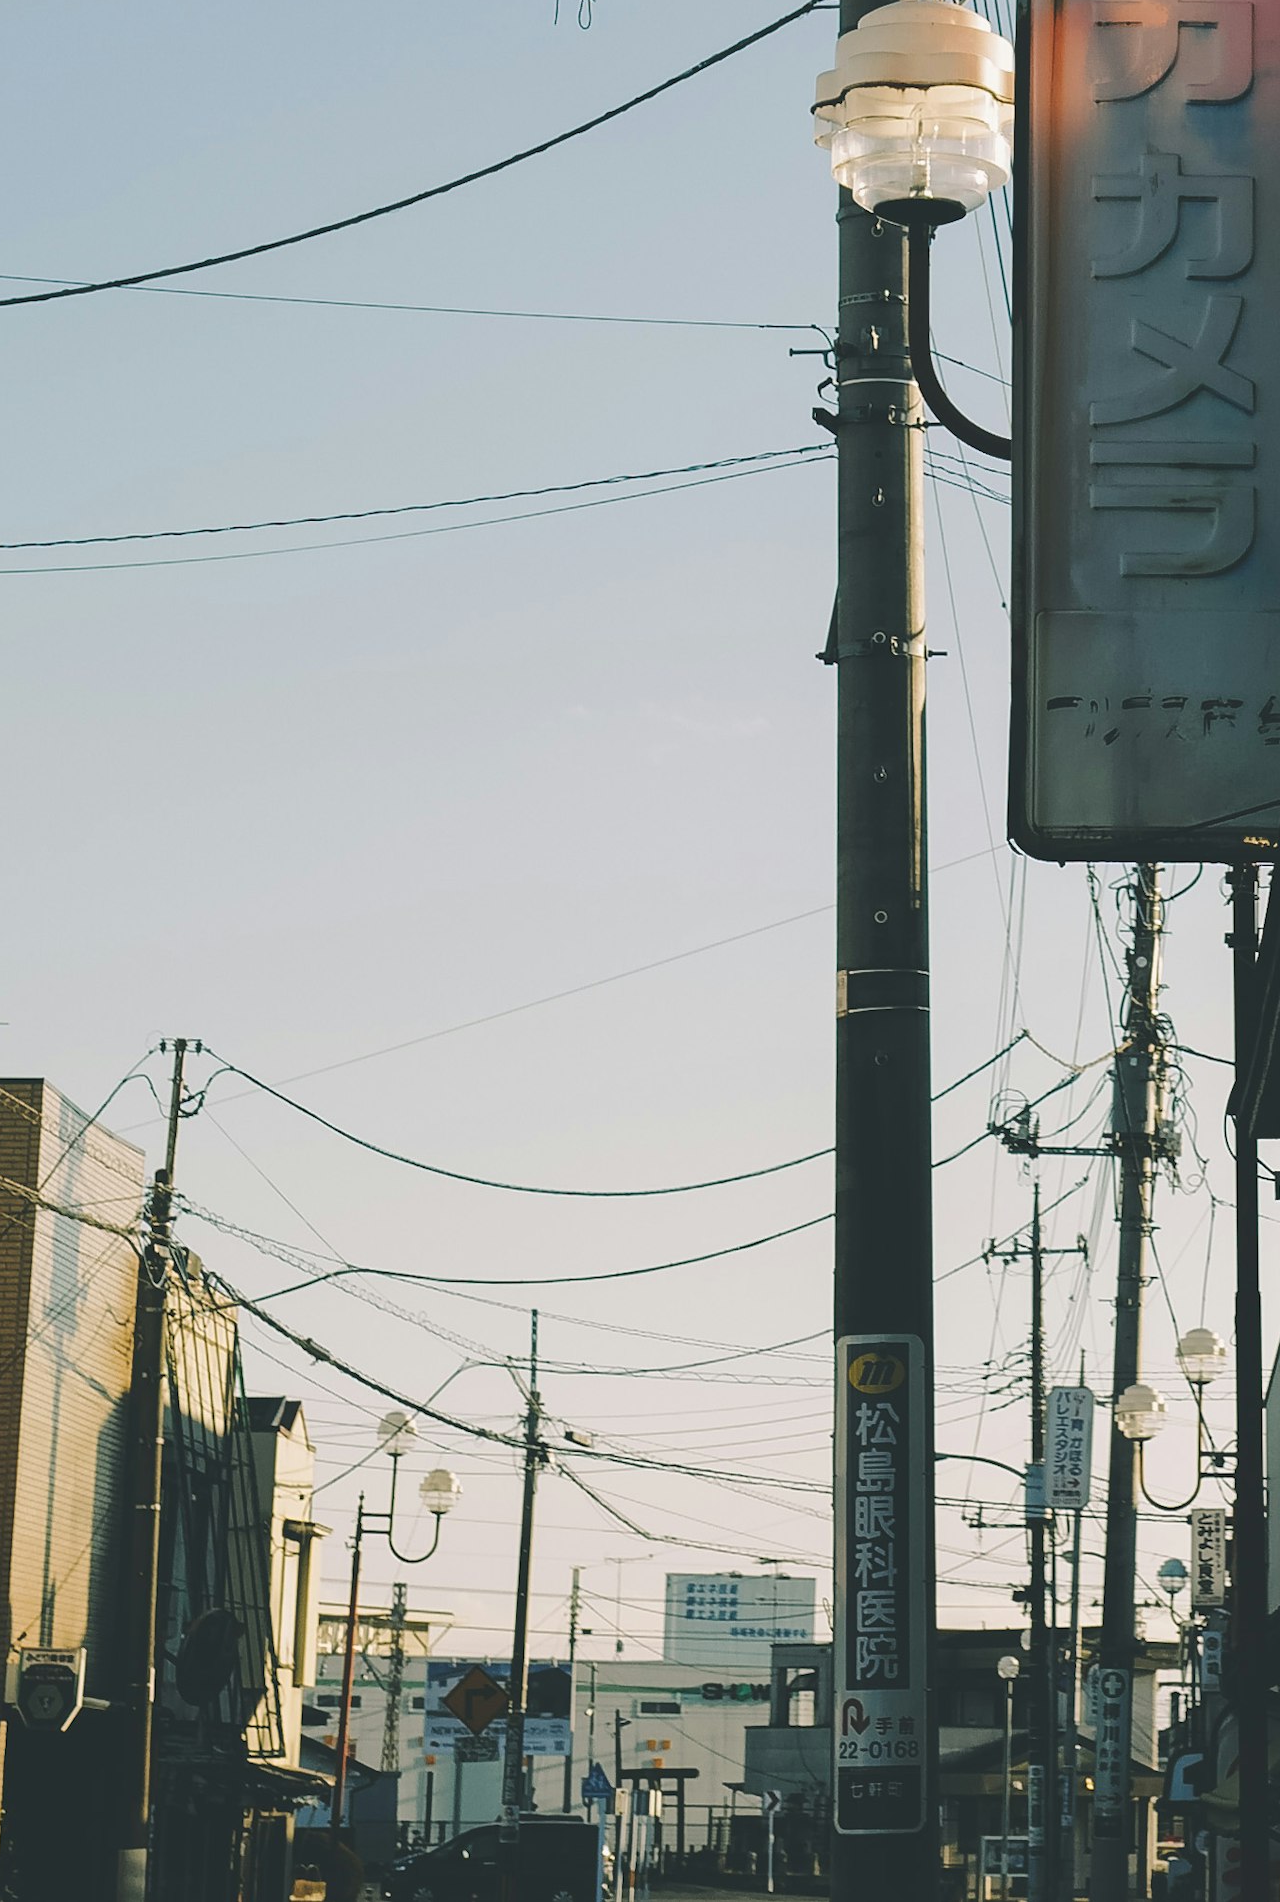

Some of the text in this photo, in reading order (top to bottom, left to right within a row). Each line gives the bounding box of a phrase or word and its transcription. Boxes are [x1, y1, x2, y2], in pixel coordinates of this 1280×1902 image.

[1053, 1391, 1071, 1475] バレエスタジオ
[854, 1402, 900, 1681] 松島眼科医院
[875, 1716, 915, 1737] 手前
[839, 1740, 920, 1760] 22-0168
[850, 1781, 904, 1799] 七軒町
